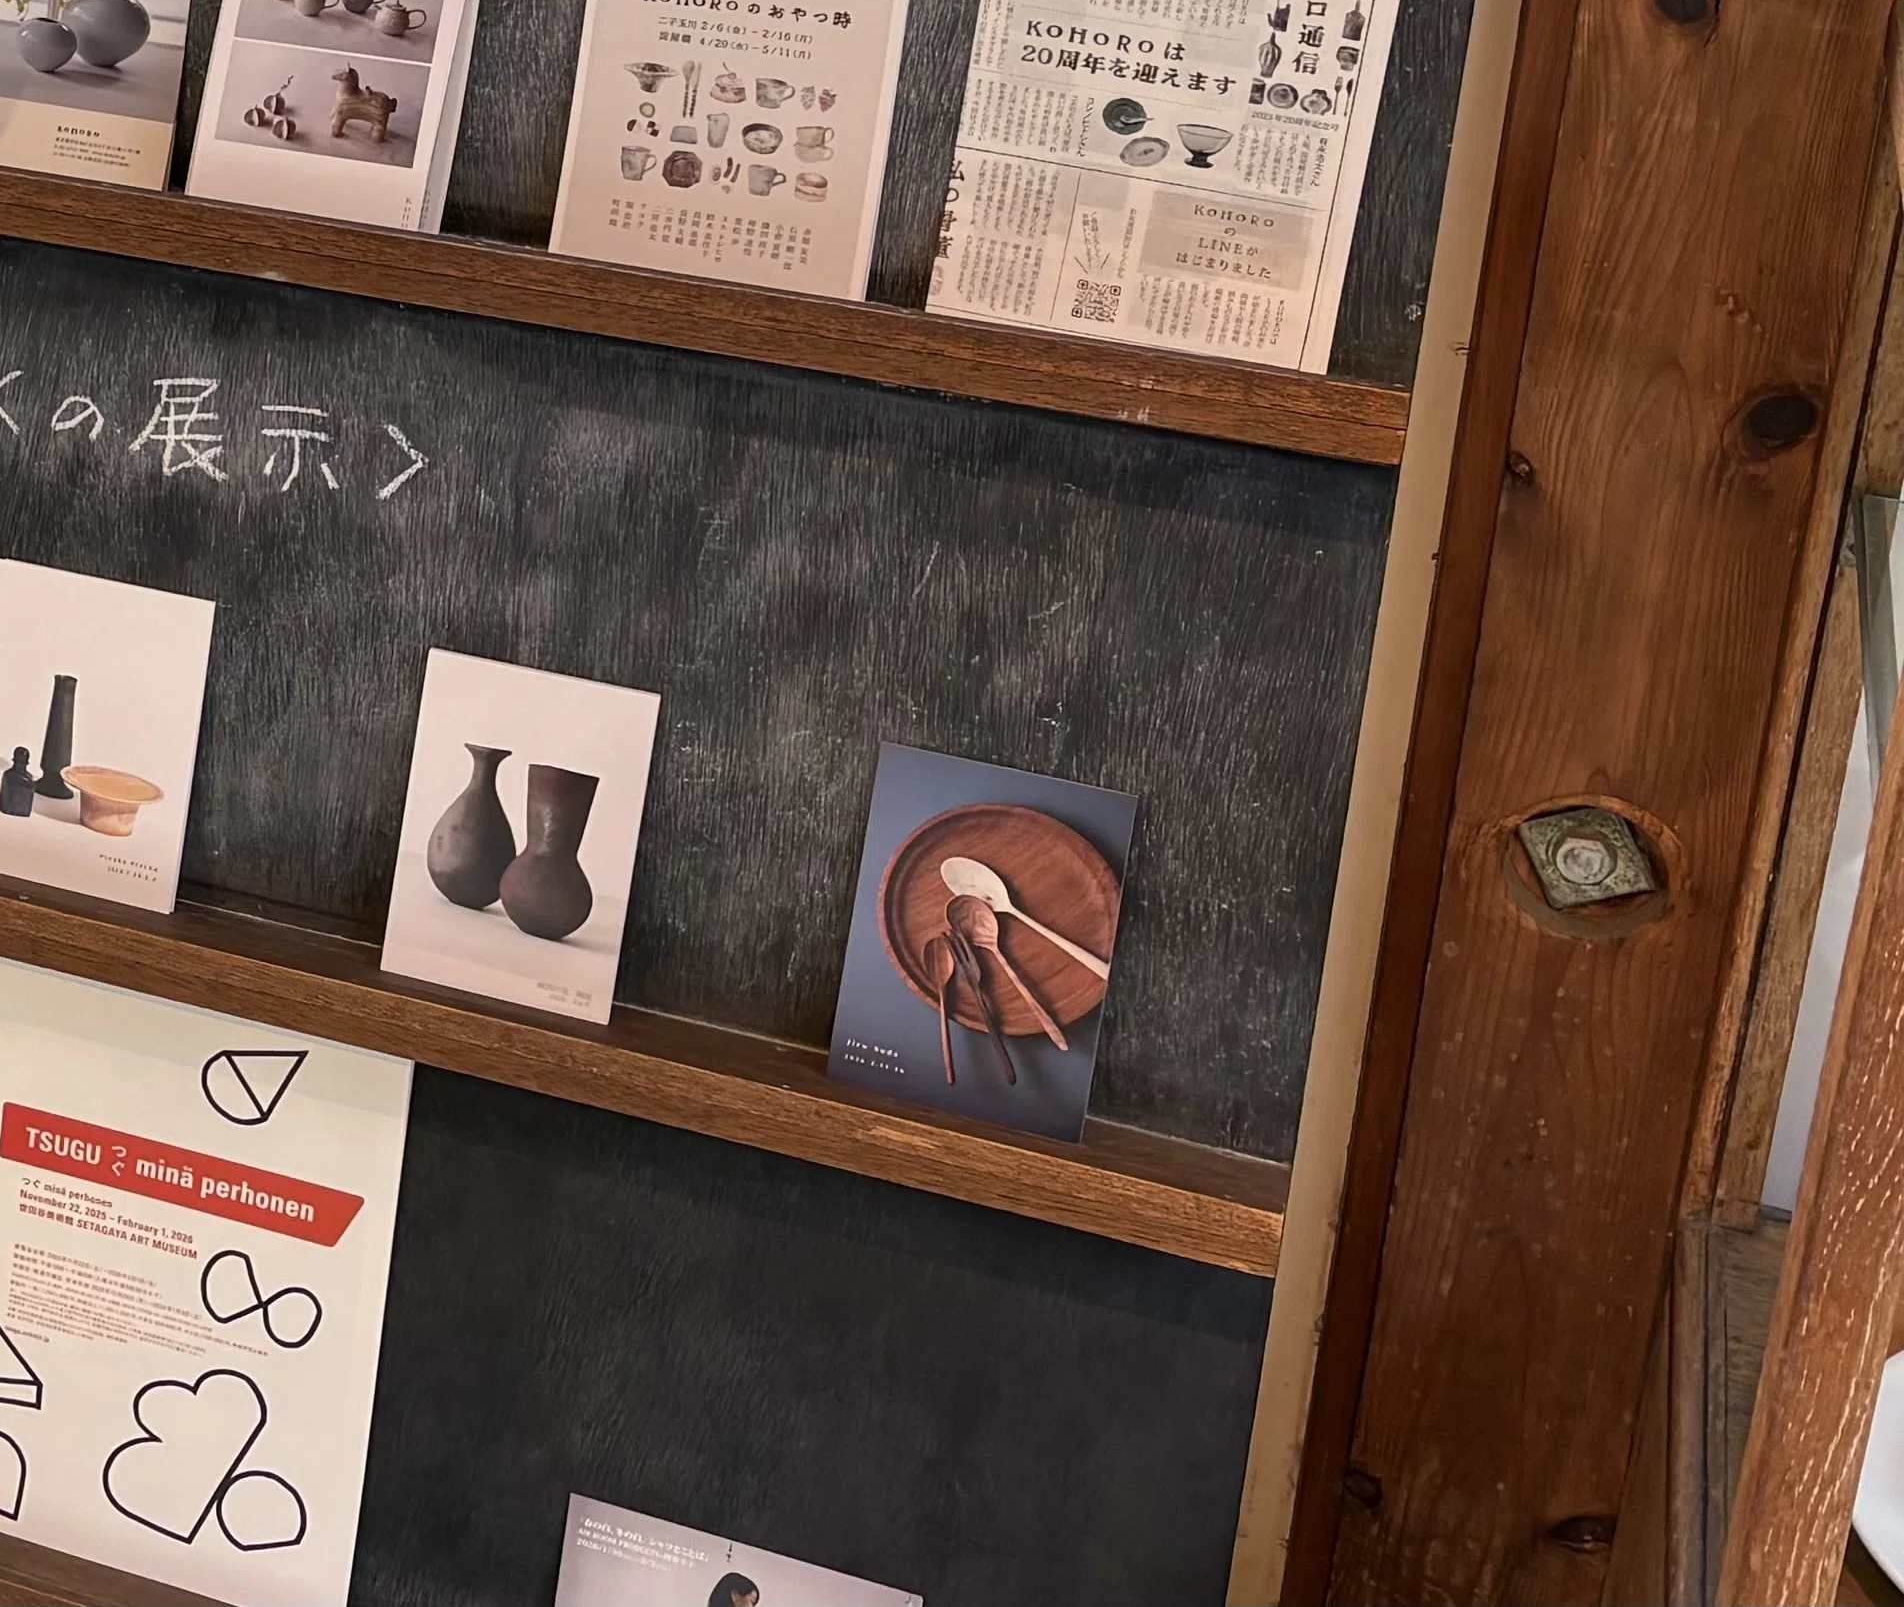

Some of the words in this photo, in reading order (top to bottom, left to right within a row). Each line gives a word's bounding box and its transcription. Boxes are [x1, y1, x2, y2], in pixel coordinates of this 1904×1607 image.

[1020, 44, 1237, 95] 20周年を迎えます
[1193, 204, 1275, 228] KOHORO
[1223, 227, 1237, 237] の
[1197, 237, 1259, 257] LINEが
[1175, 252, 1272, 280] はじまりました
[25, 1125, 102, 1166] TSUGU
[111, 1144, 127, 1178] つぐ
[135, 1157, 194, 1190] minä
[200, 1175, 315, 1223] perhonen
[19, 1189, 67, 1210] November
[69, 1201, 83, 1215] 22,
[85, 1206, 107, 1221] 2025
[117, 1215, 159, 1237] February
[170, 1230, 194, 1245] 2026
[76, 1219, 128, 1241] SETAGAYA
[129, 1232, 150, 1247] ART
[151, 1239, 198, 1260] MUSEUM
